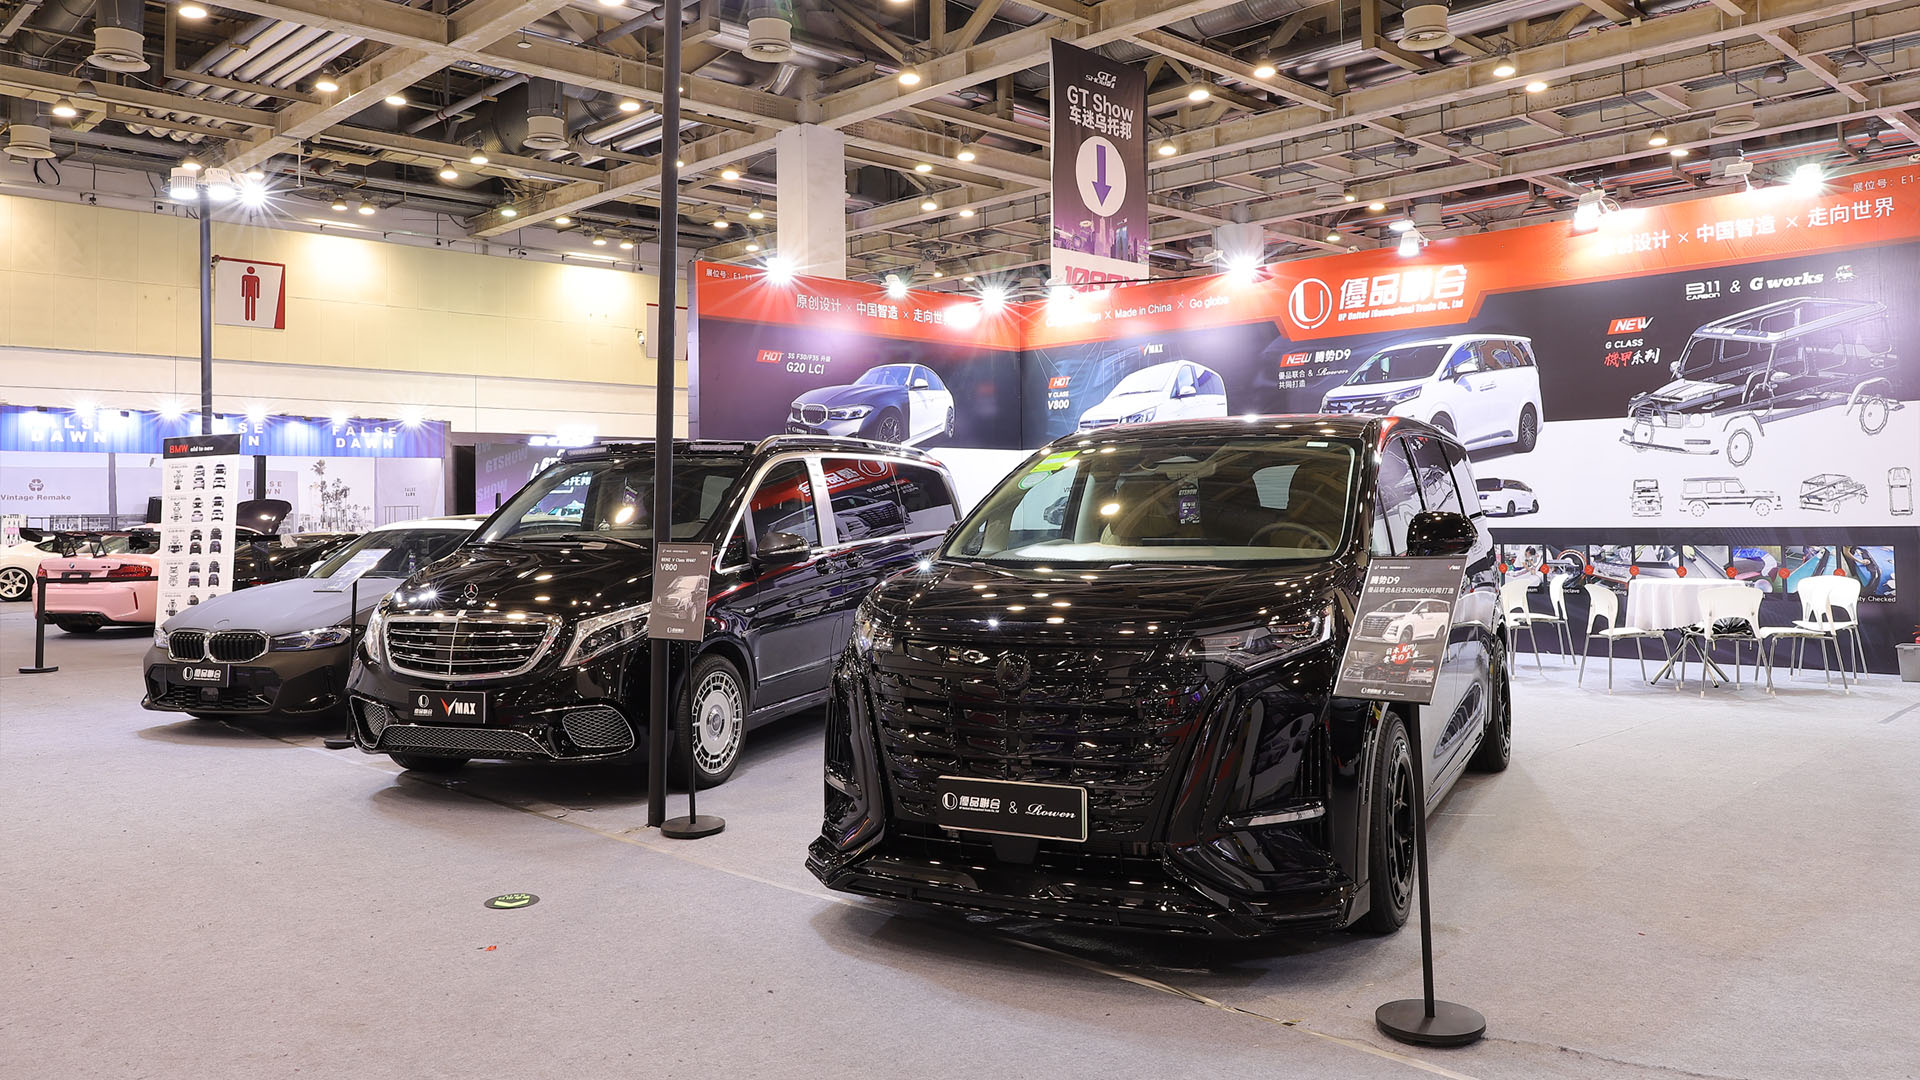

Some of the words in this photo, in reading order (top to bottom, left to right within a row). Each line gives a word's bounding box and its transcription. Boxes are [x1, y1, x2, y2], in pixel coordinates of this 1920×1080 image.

[1067, 85, 1089, 107] GT
[1093, 93, 1134, 122] Show
[1069, 105, 1132, 140] 车迷乌托邦
[1696, 216, 1776, 243] 中国智造
[1807, 197, 1895, 228] 走向世界
[1730, 280, 1741, 293] &
[1750, 277, 1764, 290] G
[1766, 272, 1824, 289] works
[796, 294, 842, 312] 原创设计
[857, 302, 898, 320] 中国智造
[1115, 308, 1137, 319] Made
[1139, 306, 1146, 315] in
[1148, 303, 1172, 314] China
[1189, 298, 1202, 308] Go
[1614, 316, 1655, 332] NEW
[1614, 338, 1644, 348] CLASS
[763, 352, 784, 361] HOT
[1286, 353, 1312, 364] NEW
[786, 362, 806, 373] G20
[808, 364, 824, 374] LCI
[1048, 400, 1070, 410] V800
[31, 431, 107, 443] DAWN
[332, 425, 397, 437] FALSE
[169, 445, 188, 453] BMW
[336, 438, 394, 448] DAWN
[660, 563, 678, 571] V800
[1008, 801, 1018, 814] &
[1025, 803, 1077, 818] Rowen
